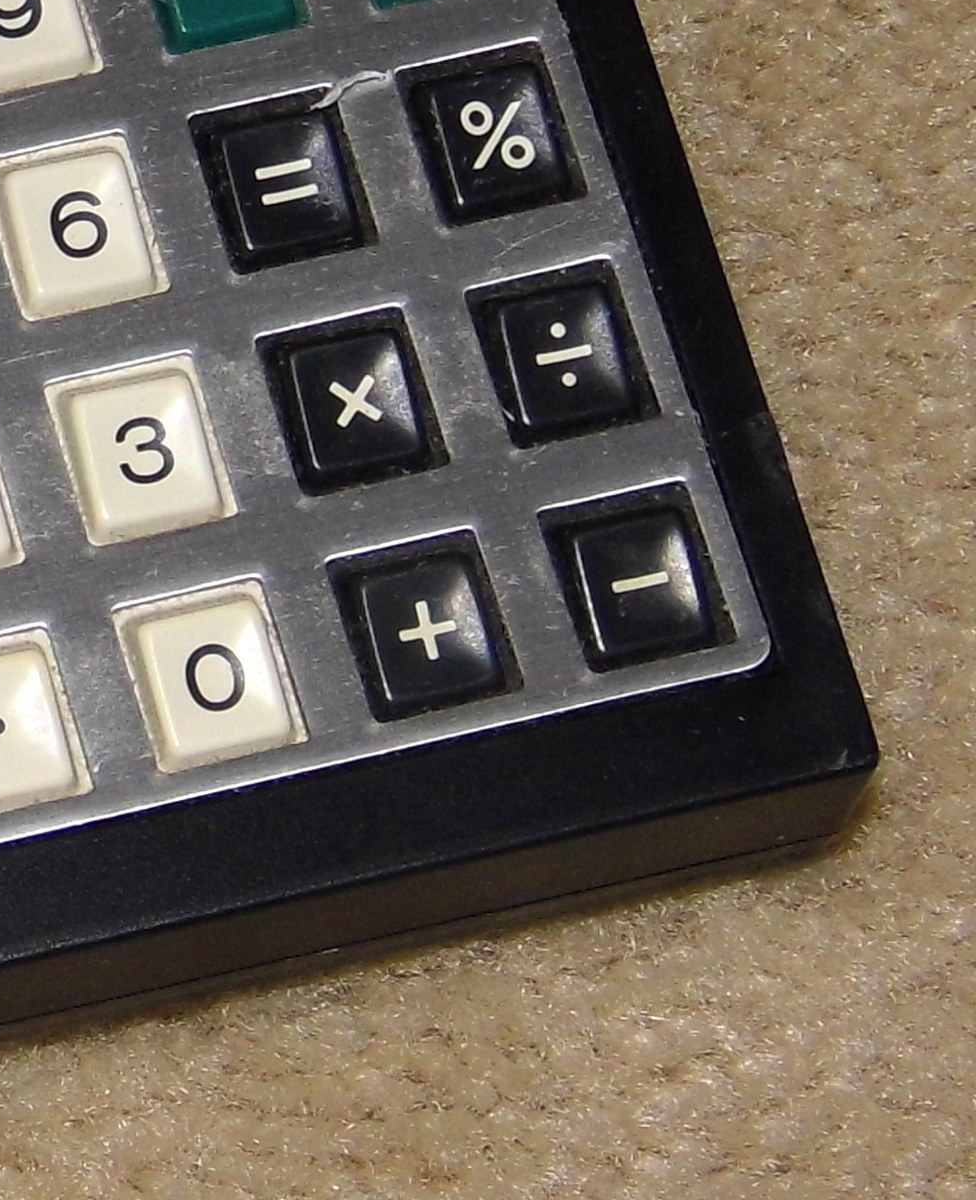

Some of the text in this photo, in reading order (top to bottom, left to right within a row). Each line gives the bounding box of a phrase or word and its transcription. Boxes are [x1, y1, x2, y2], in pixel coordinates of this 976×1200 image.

[458, 100, 534, 171] %
[50, 191, 108, 259] 6
[116, 417, 175, 485] 3
